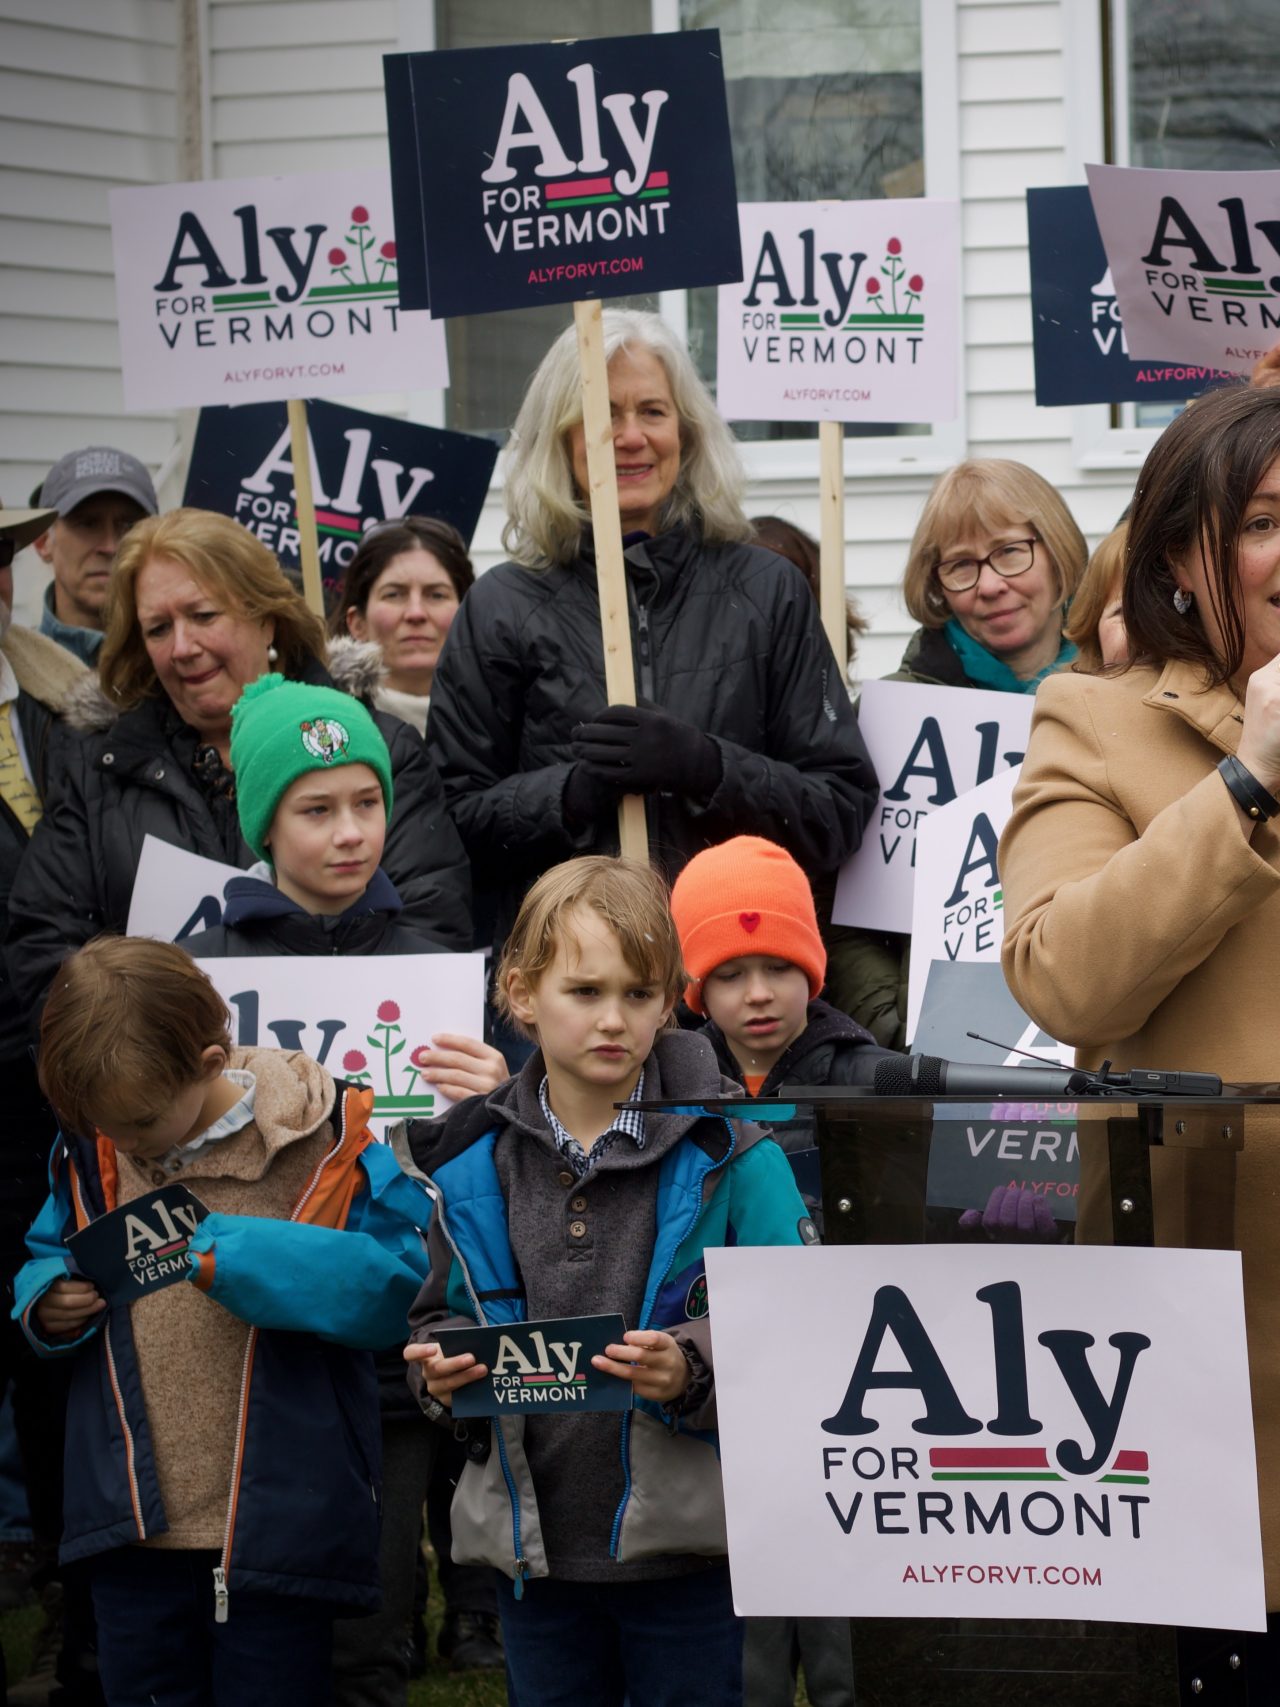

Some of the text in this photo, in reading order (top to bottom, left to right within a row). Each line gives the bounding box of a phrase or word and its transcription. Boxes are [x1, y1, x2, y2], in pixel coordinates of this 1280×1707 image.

[480, 63, 669, 196] Aly
[482, 185, 541, 216] FOR
[483, 201, 671, 254] VERMONT
[153, 204, 328, 302] Aly
[527, 256, 645, 284] ALYFORVT.COM
[742, 228, 868, 327] Aly
[1145, 270, 1199, 292] FOR
[155, 296, 207, 316] FOR
[158, 305, 400, 349] VERMONT
[742, 313, 776, 331] FOR
[743, 336, 924, 364] VERMONT
[223, 362, 346, 384] ALYFORVT.COM
[783, 388, 872, 402] ALYFORVT.COM
[235, 492, 291, 523] FOR
[943, 897, 988, 934] FOR
[124, 1199, 197, 1261] Aly
[127, 1253, 157, 1273] FOR
[491, 1331, 582, 1384] Aly
[492, 1376, 522, 1388] FOR
[820, 1280, 1151, 1475] Aly
[494, 1385, 588, 1404] VERMONT
[822, 1446, 920, 1480] FOR
[825, 1491, 1151, 1539] VERMONT
[902, 1564, 1102, 1586] ALYFORVT.COM
